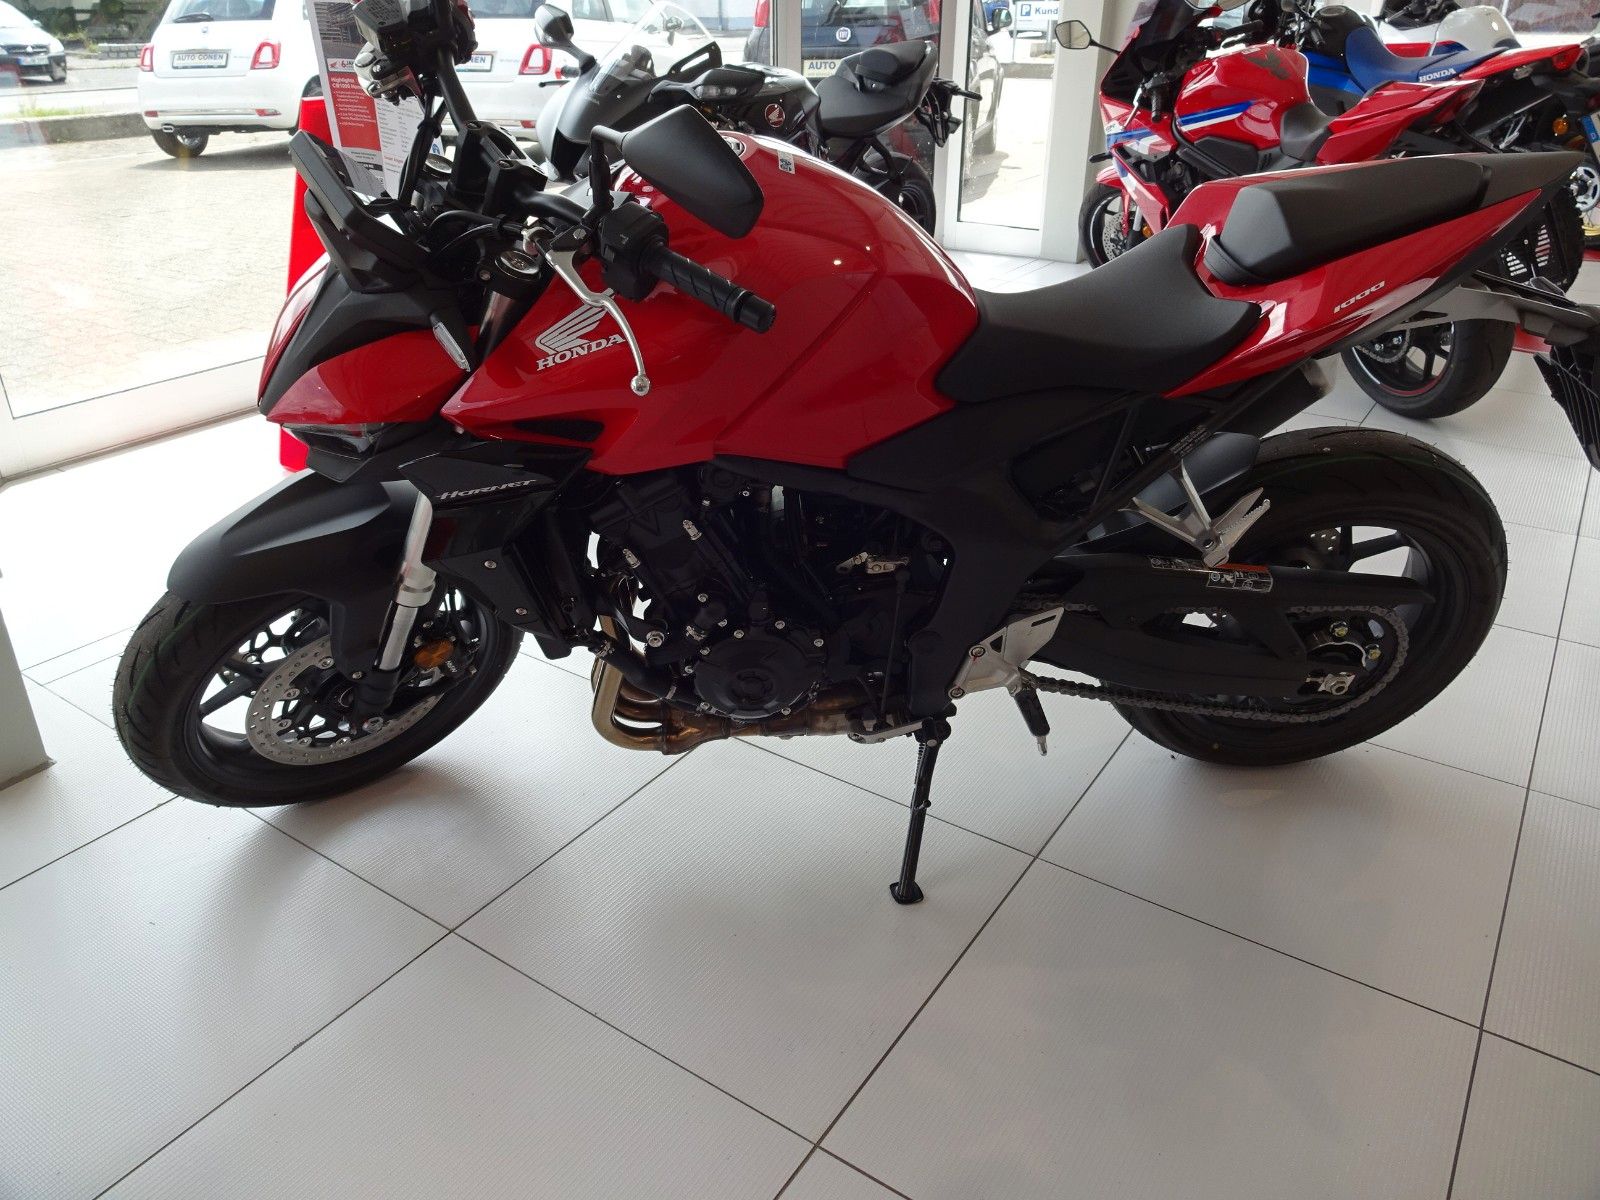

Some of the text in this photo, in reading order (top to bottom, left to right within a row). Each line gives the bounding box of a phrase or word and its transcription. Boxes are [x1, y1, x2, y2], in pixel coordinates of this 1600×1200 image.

[808, 61, 836, 70] AUTO
[1419, 68, 1456, 82] HONDA
[1333, 281, 1385, 313] 1000
[536, 334, 626, 371] HONDA
